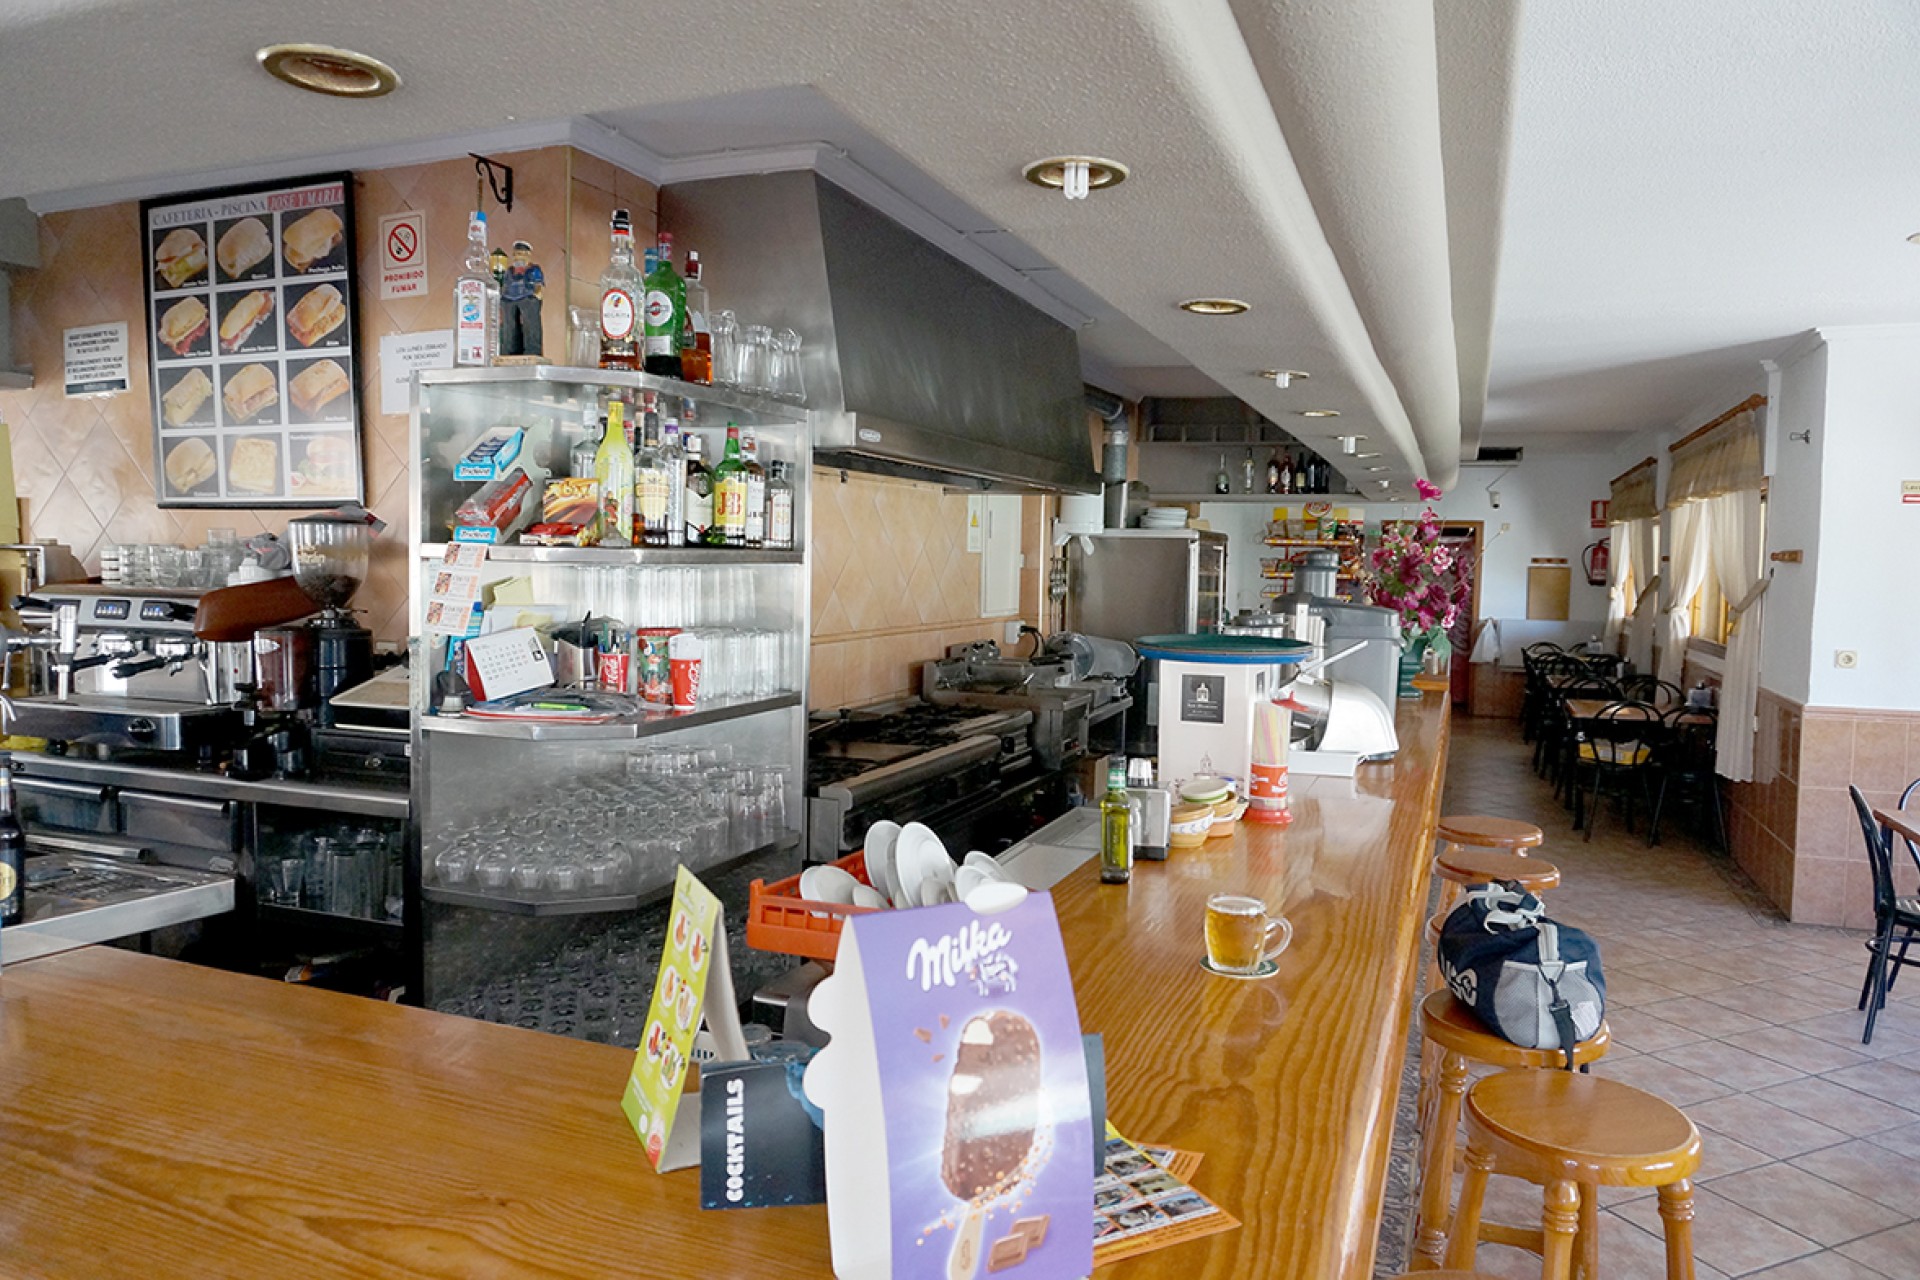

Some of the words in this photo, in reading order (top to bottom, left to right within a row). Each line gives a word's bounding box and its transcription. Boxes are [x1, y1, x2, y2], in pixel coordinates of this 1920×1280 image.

[384, 270, 424, 282] PROHIBIDO
[391, 283, 417, 293] FUMAR
[461, 467, 490, 476] Trident
[461, 531, 490, 540] Trident
[906, 919, 1013, 992] Milka
[726, 1078, 744, 1203] COCKTAILS
